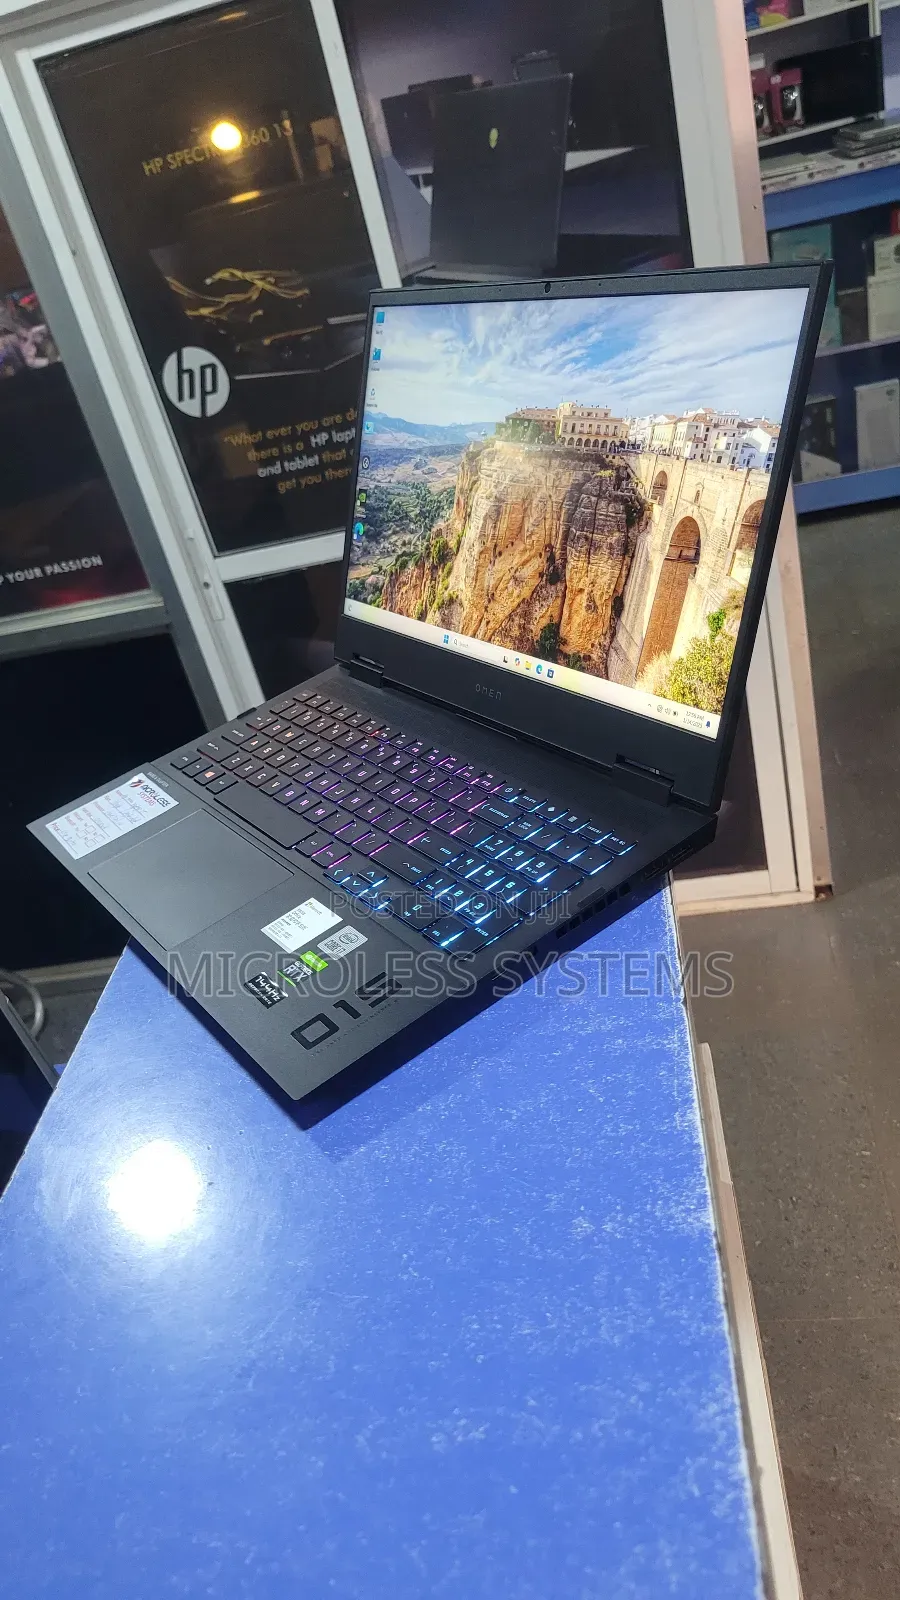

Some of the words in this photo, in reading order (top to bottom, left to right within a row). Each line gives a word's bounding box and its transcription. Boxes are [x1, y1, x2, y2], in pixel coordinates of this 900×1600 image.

[141, 157, 164, 177] HP
[173, 348, 222, 417] hp
[266, 426, 292, 439] ever
[295, 420, 318, 435] you
[321, 414, 342, 427] are
[247, 447, 279, 462] there
[282, 444, 293, 454] is
[295, 441, 304, 451] a
[310, 432, 329, 448] HP
[257, 461, 282, 478] and
[283, 454, 319, 472] tablet
[322, 448, 347, 463] that
[277, 478, 297, 494] get
[300, 474, 322, 489] you
[5, 566, 43, 583] YOUR
[44, 555, 104, 576] PASSION
[475, 684, 502, 701] OMEN
[283, 965, 310, 982] RTX
[255, 976, 281, 1001] 144Hz
